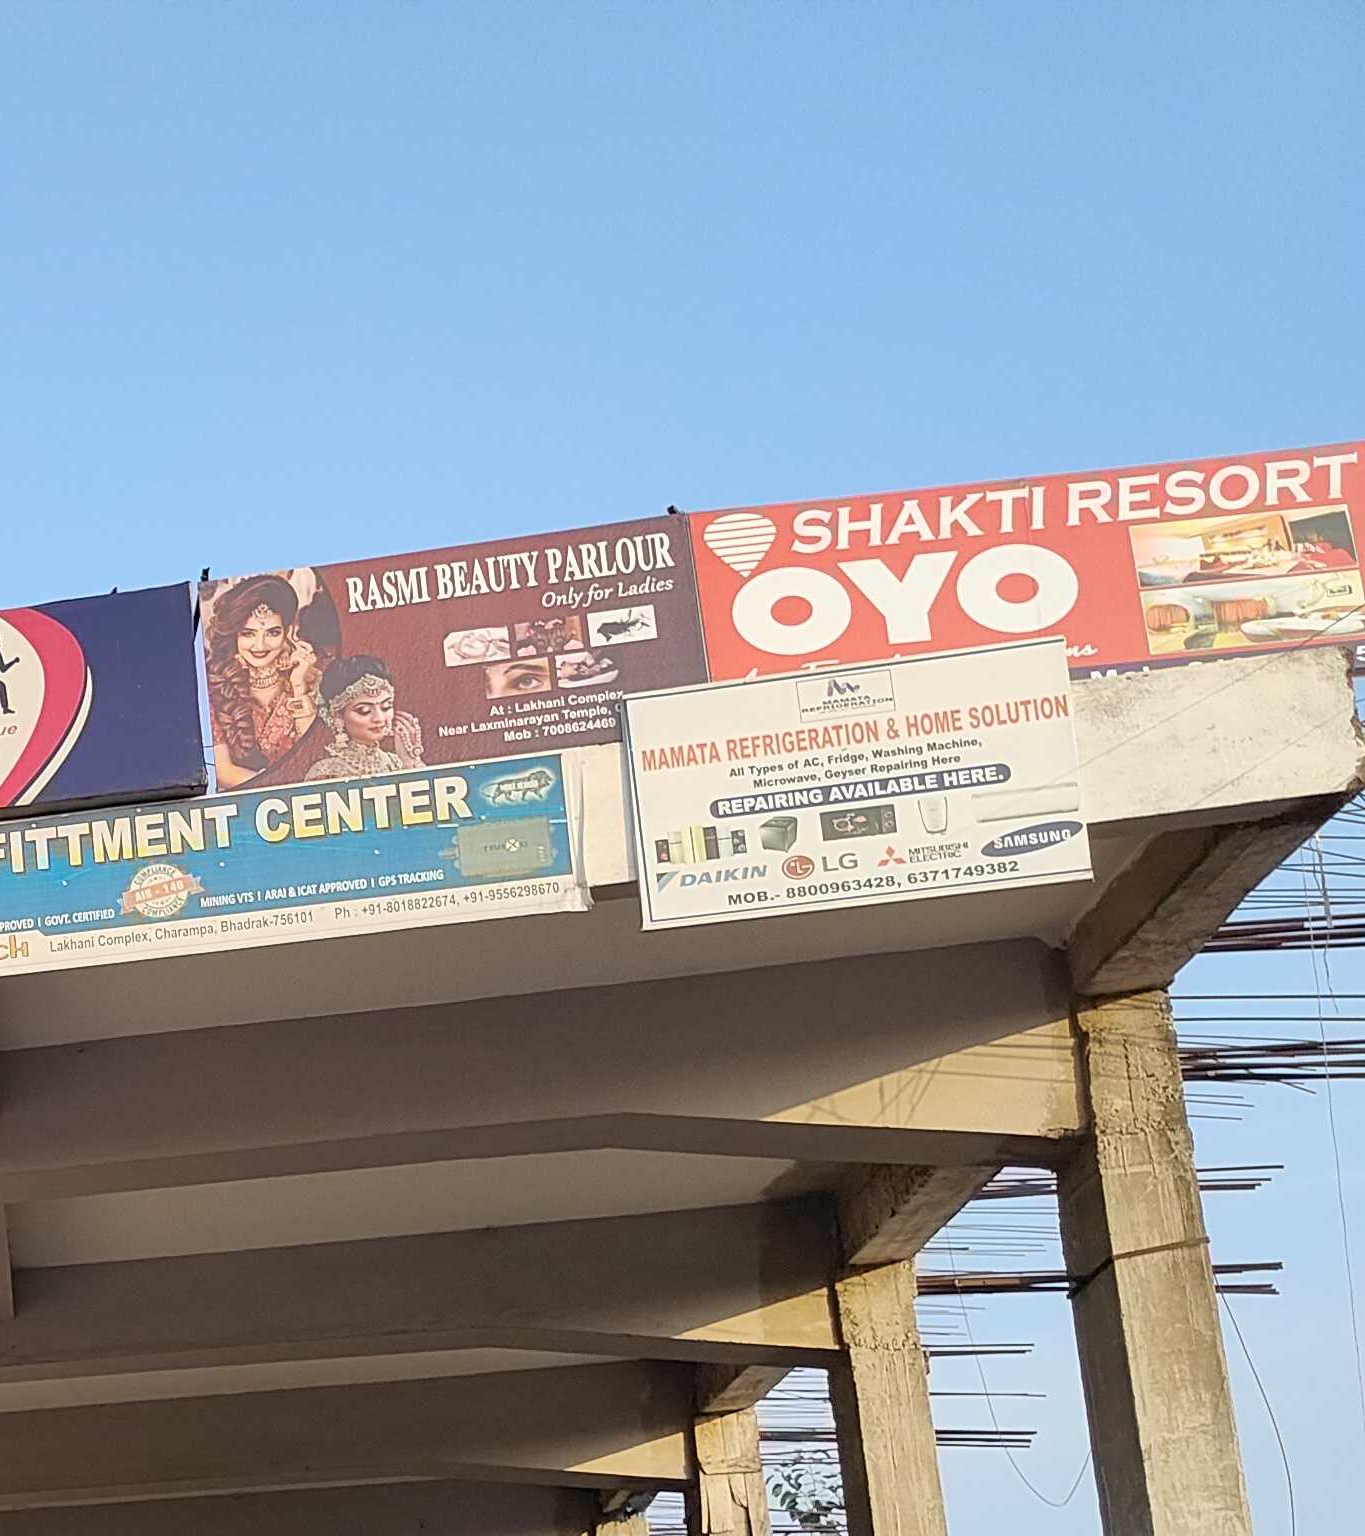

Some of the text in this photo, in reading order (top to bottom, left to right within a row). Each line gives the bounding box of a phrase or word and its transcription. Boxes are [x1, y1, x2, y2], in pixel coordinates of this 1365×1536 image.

[791, 452, 1359, 556] SHAKTI RESORT
[346, 532, 675, 614] RASMI BEAUTY PARLOUR
[541, 575, 675, 609] Only for Ladies
[731, 543, 1080, 656] OYO
[439, 726, 468, 737] Near
[504, 731, 531, 742] Mob
[642, 694, 1070, 772] MAMATA REFRIGERATION & HOME SOLUTION
[729, 744, 923, 777] All Types of Washing
[825, 754, 961, 782] Geyser Here
[254, 774, 473, 844] CENTER
[716, 774, 938, 817] REPAIRING AVAILABLE
[993, 828, 1072, 851] SAMSUNG
[821, 852, 859, 873] LG
[909, 850, 962, 864] ELECTRIC
[319, 869, 445, 894] APPROVED TRACKING
[679, 865, 767, 888] DAIKIN
[49, 935, 95, 953] Lakhani
